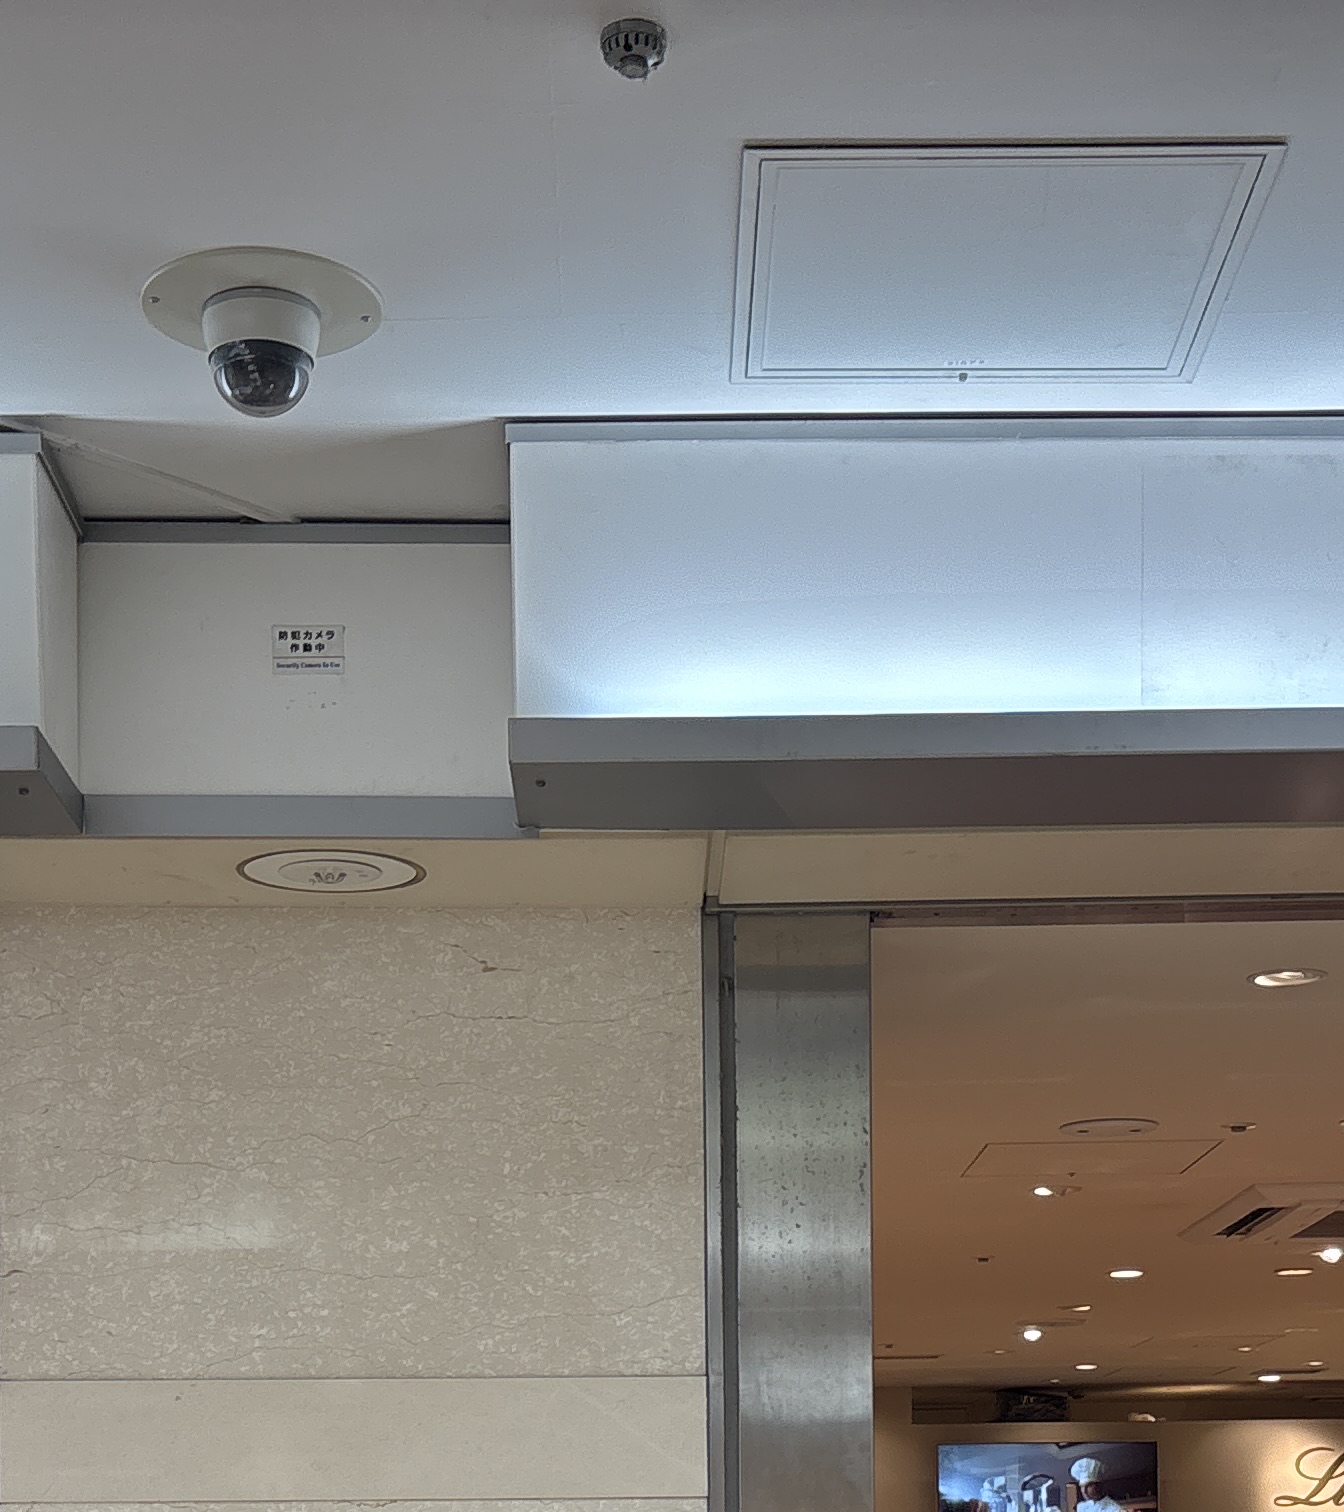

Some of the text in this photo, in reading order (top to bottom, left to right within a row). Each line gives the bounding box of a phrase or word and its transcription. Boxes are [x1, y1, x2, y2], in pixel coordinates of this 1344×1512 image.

[278, 630, 335, 641] 防犯カメラ
[290, 643, 325, 653] 作動中
